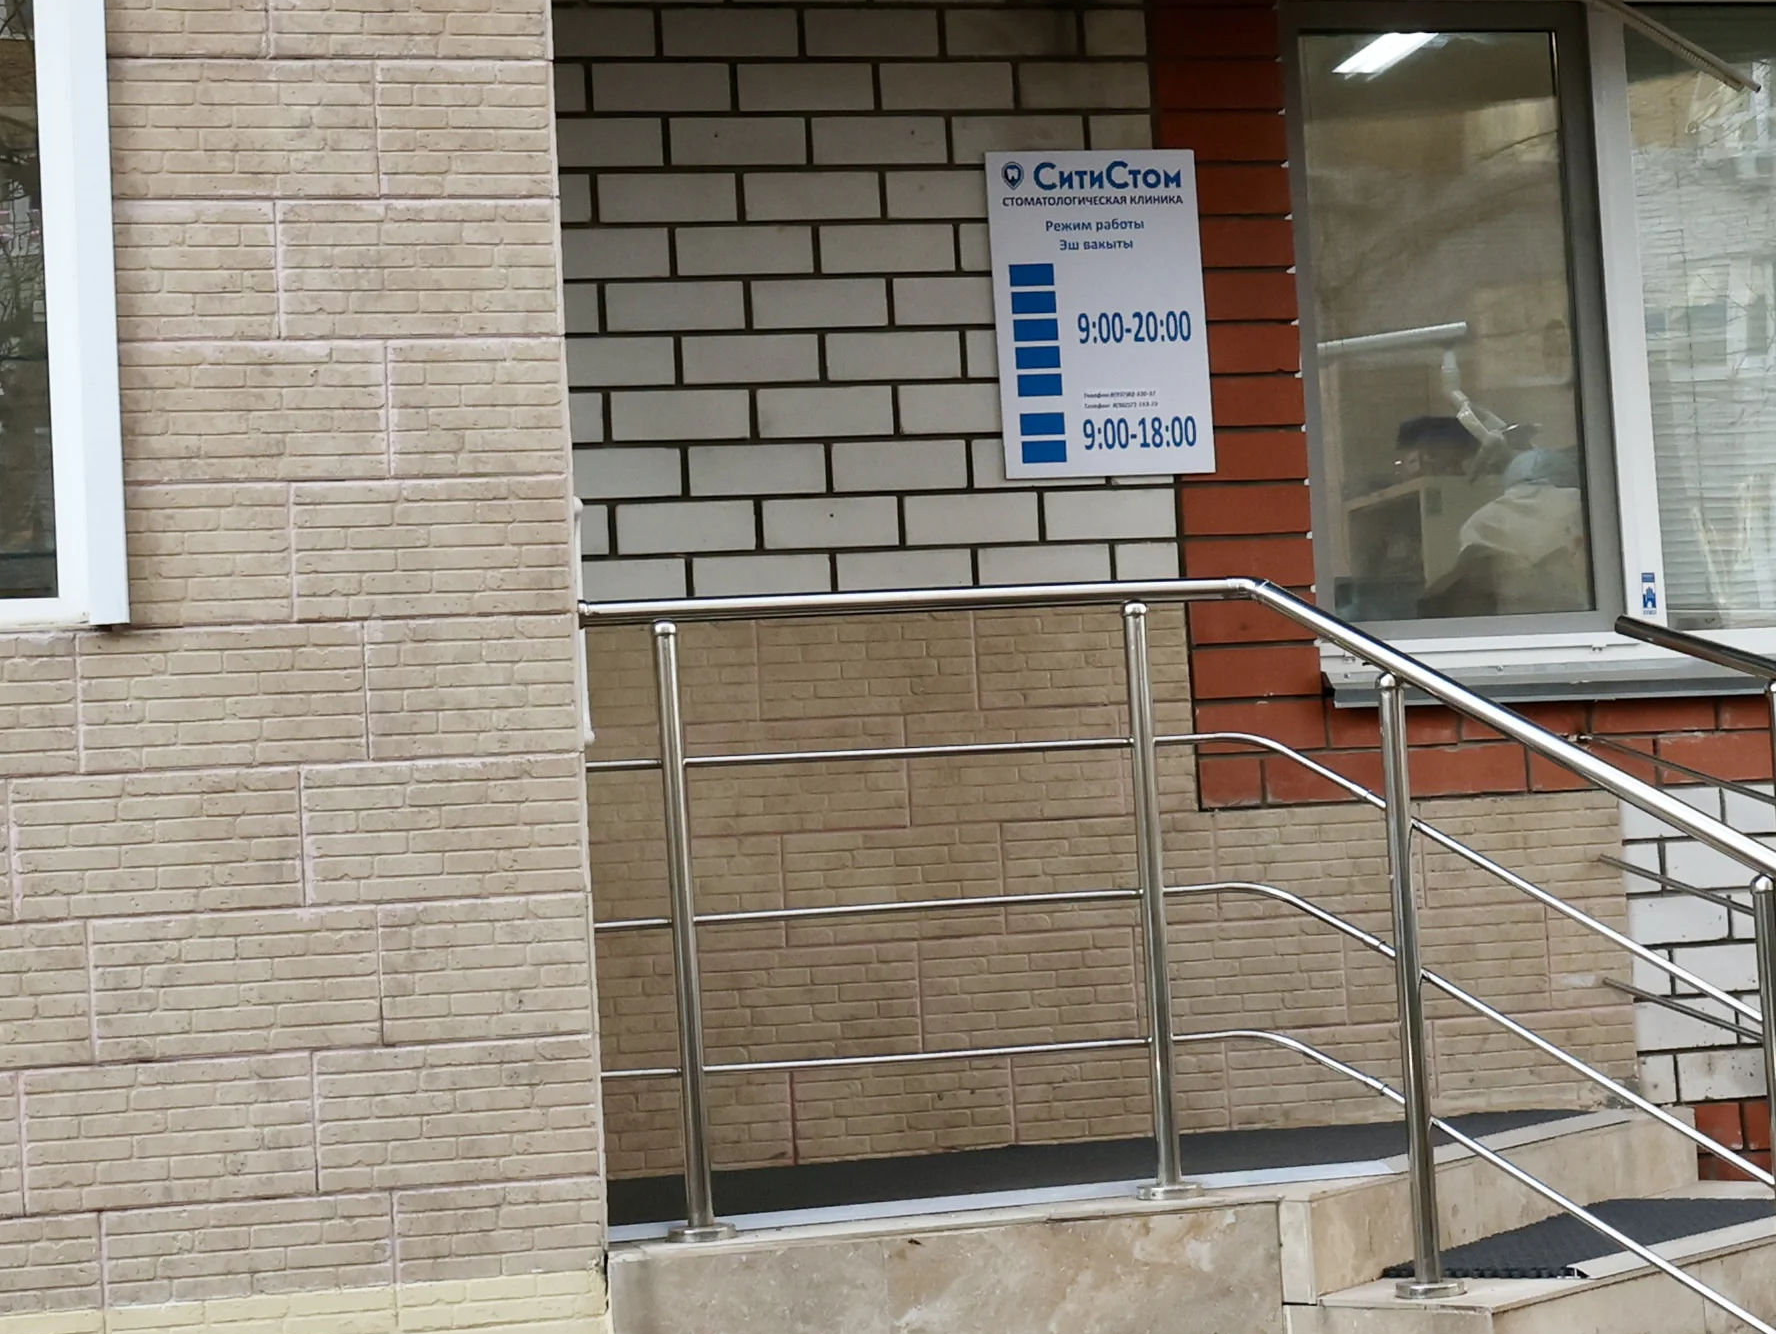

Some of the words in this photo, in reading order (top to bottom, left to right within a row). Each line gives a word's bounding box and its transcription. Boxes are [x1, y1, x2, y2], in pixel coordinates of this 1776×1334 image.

[1033, 160, 1182, 191] СитиСтом
[1002, 195, 1127, 207] СТОМАТОЛОГИЧЕСКАЯ
[1129, 194, 1184, 206] КЛИНИКА
[1045, 219, 1093, 232] Режим
[1096, 217, 1145, 233] работы
[1059, 239, 1080, 251] Эш
[1084, 239, 1134, 251] вакыты
[1077, 310, 1192, 344] 9:00-20:00
[1082, 415, 1198, 450] 9:00-18:00
